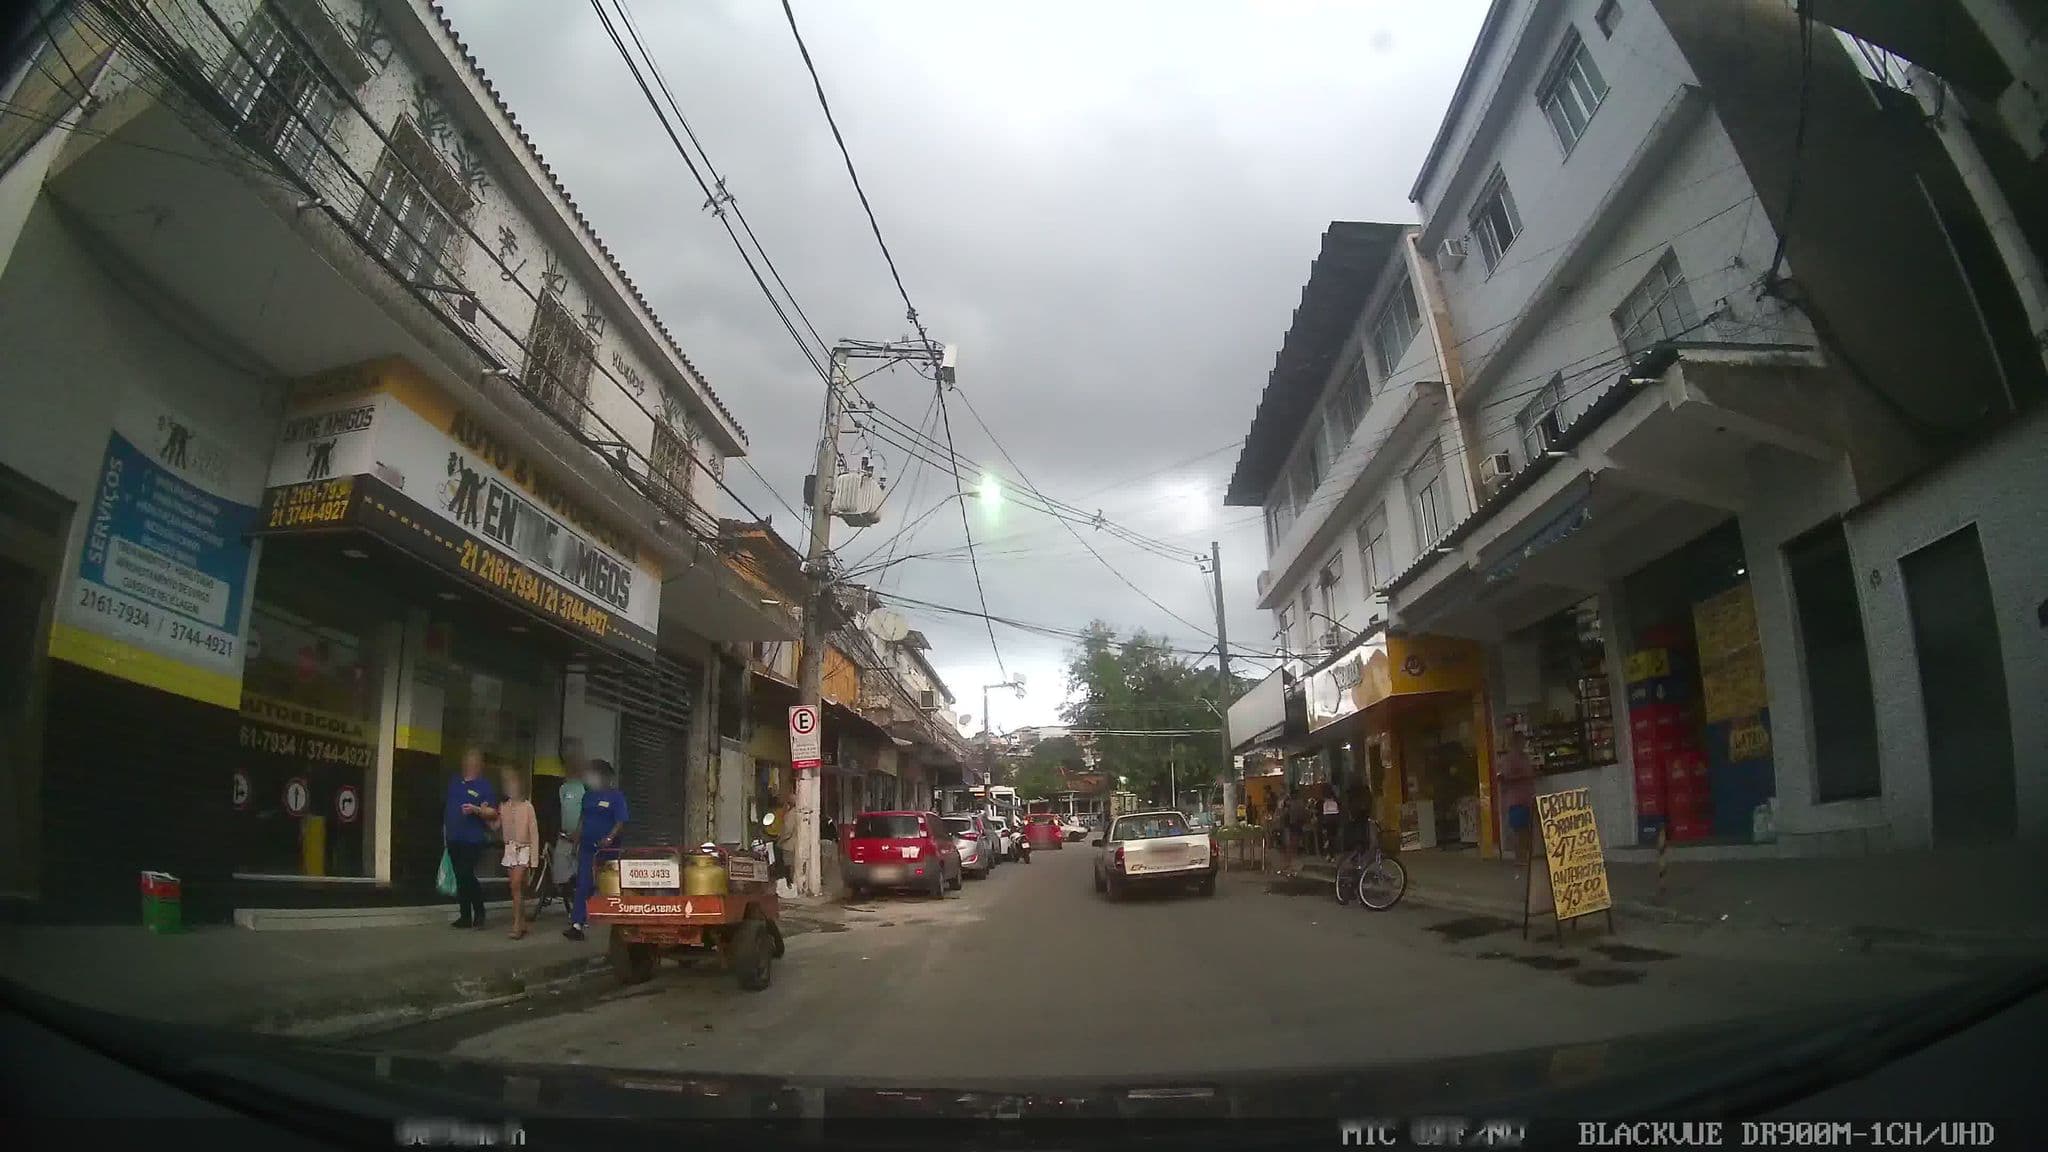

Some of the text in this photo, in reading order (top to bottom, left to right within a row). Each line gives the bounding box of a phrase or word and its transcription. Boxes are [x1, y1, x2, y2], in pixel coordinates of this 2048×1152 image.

[324, 407, 374, 436] AMIGOS
[269, 507, 284, 528] 21
[461, 539, 479, 572] 21
[80, 588, 150, 629] 2161-7934
[800, 713, 809, 729] E
